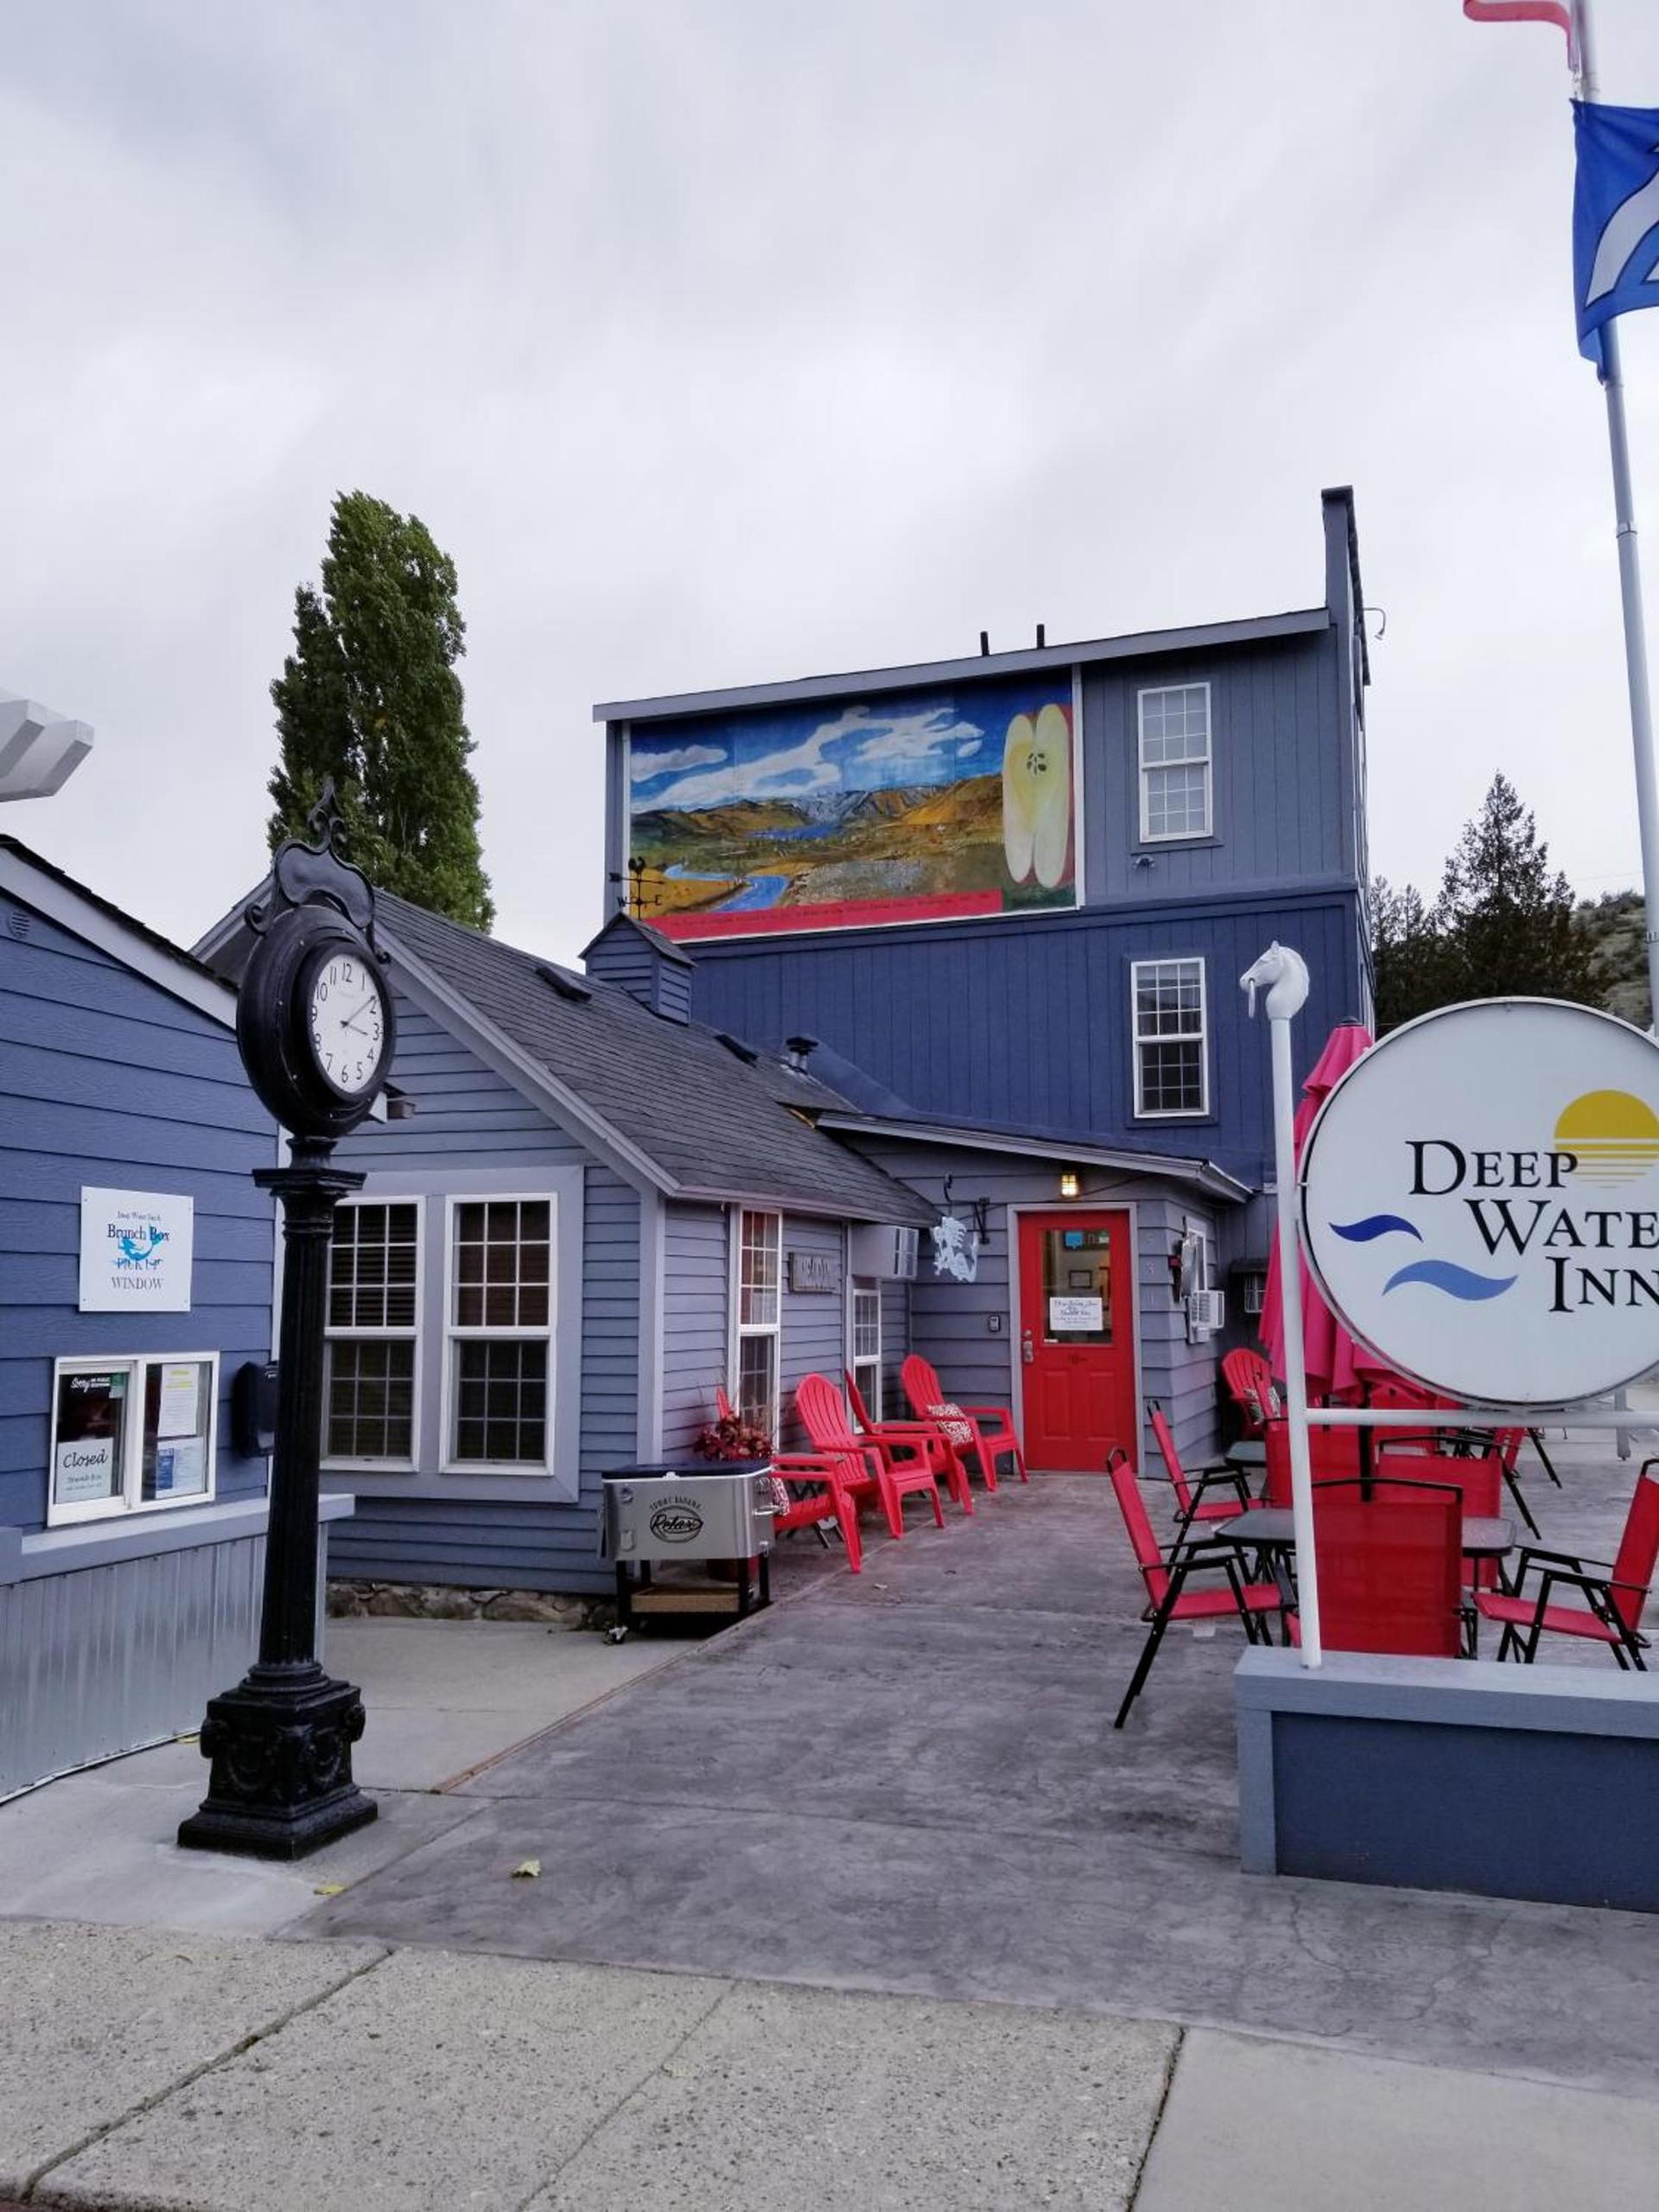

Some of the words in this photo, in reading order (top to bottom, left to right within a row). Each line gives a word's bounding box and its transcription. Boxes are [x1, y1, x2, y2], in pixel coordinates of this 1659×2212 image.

[329, 965, 337, 985] 11
[341, 963, 353, 983] 12
[361, 971, 365, 992] 1
[315, 982, 328, 1002] 10
[372, 1022, 380, 1041] 3
[315, 1033, 322, 1052] 8
[326, 1052, 334, 1071] 7
[366, 1046, 374, 1065] 4
[341, 1064, 349, 1084] 6
[356, 1061, 363, 1080] 5
[1404, 1140, 1578, 1195] DEEP
[107, 1223, 147, 1240] Brunch
[149, 1225, 170, 1242] Box
[111, 1276, 165, 1290] WINDOW
[1545, 1255, 1659, 1313] INN
[63, 1448, 108, 1468] Closed
